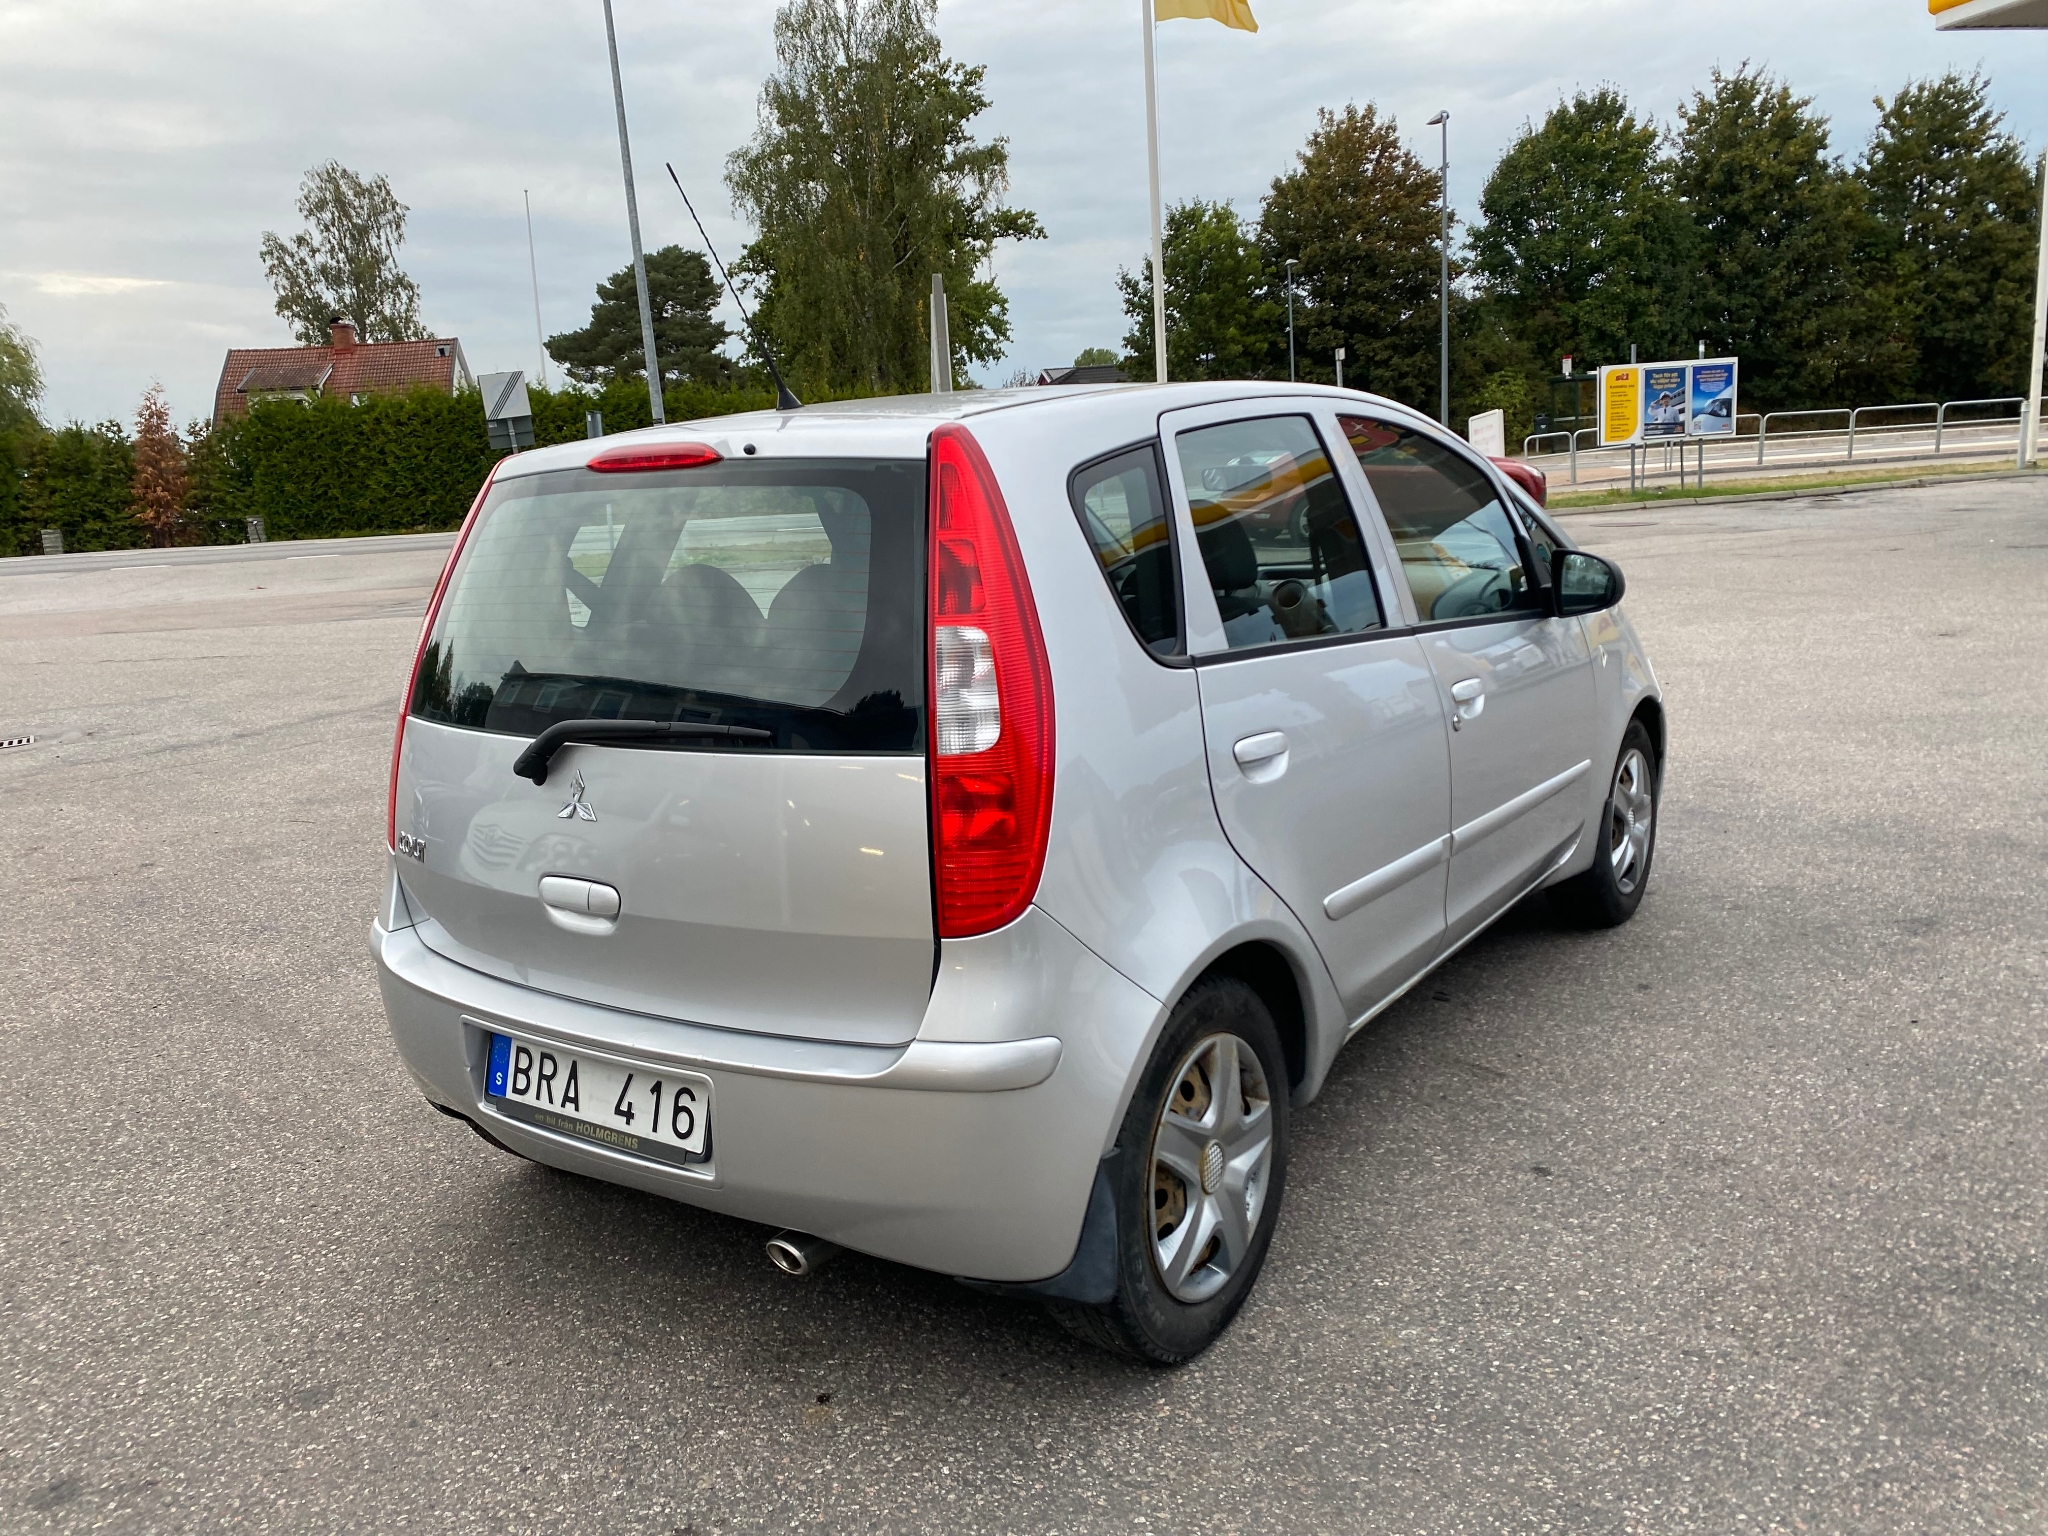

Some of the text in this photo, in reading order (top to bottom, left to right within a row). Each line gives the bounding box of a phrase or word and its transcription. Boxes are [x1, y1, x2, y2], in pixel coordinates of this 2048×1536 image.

[495, 1046, 696, 1140] S BRA 416
[558, 1118, 573, 1130] från
[576, 1121, 638, 1150] HOLMGRENS
